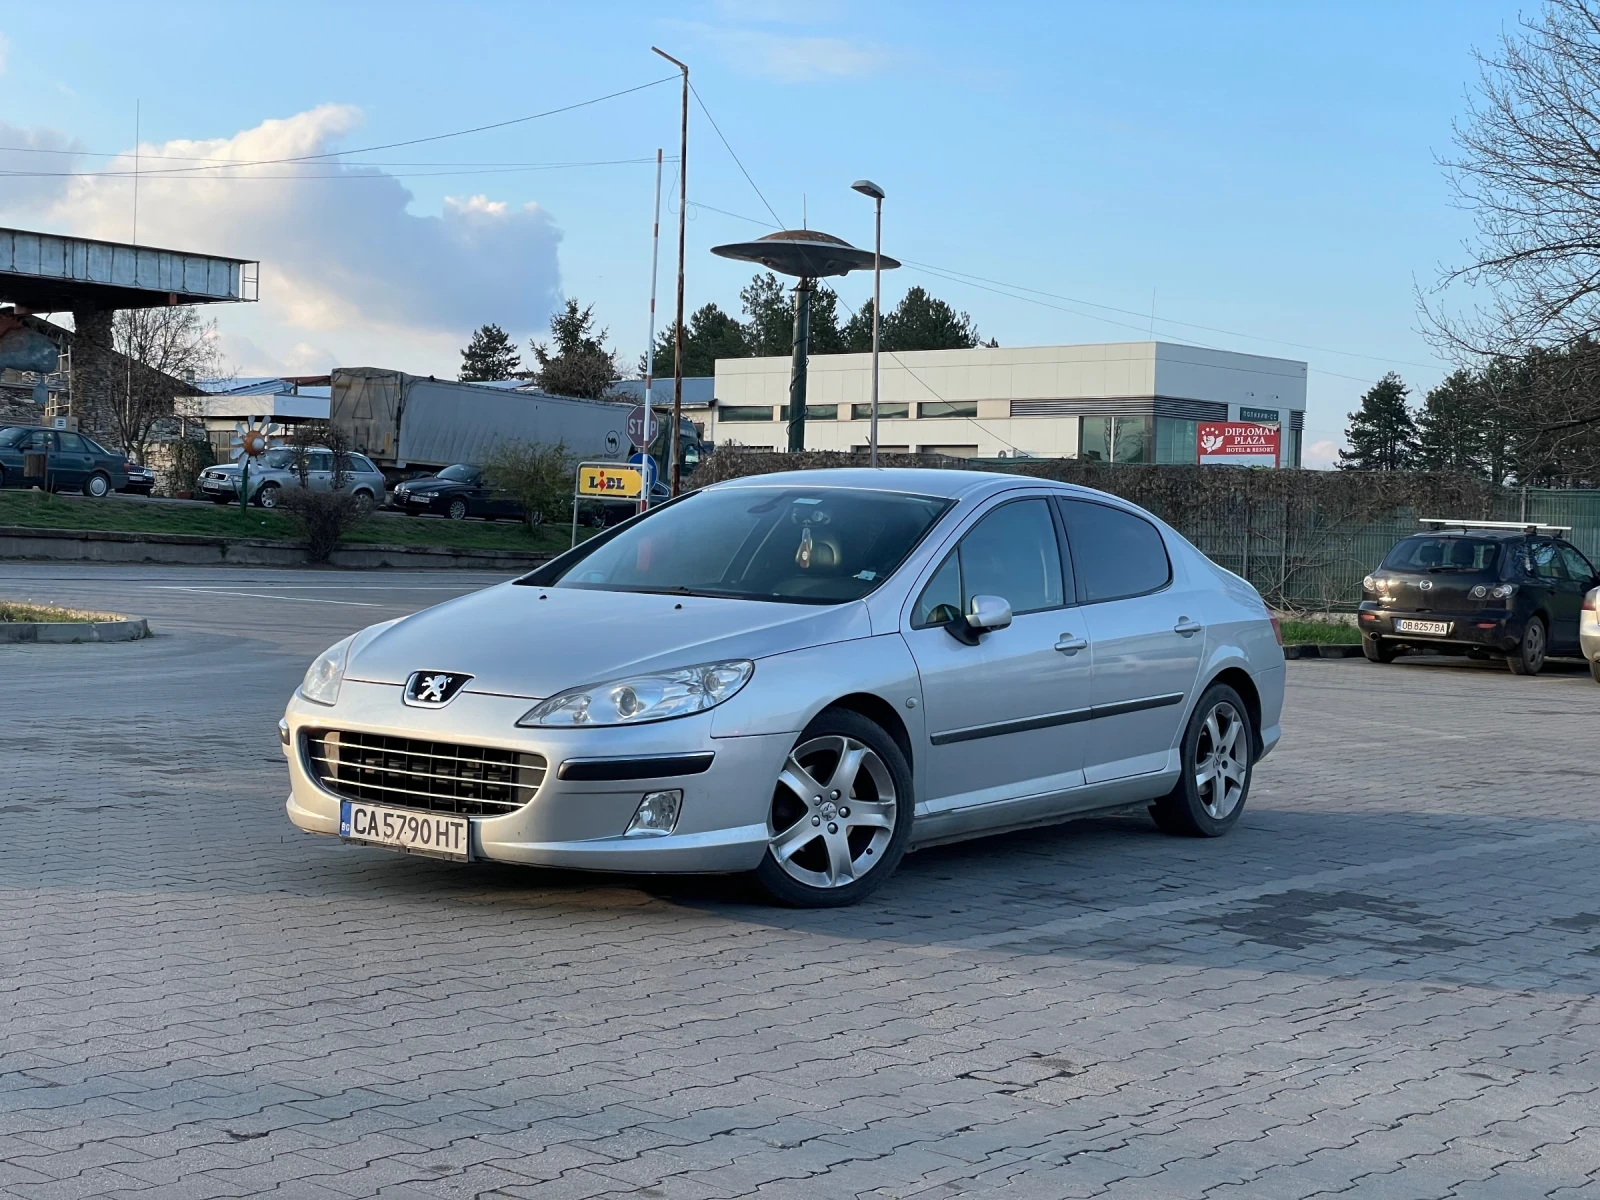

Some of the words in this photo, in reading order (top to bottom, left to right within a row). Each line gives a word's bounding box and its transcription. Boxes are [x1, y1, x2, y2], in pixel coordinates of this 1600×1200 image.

[629, 418, 656, 436] STP
[1225, 427, 1275, 436] DIPLOMAT
[1234, 436, 1266, 445] PLAZA
[1414, 622, 1434, 632] 8257
[341, 822, 350, 832] BG
[353, 808, 379, 837] CA
[383, 812, 432, 845] 5790
[435, 819, 464, 849] HT
